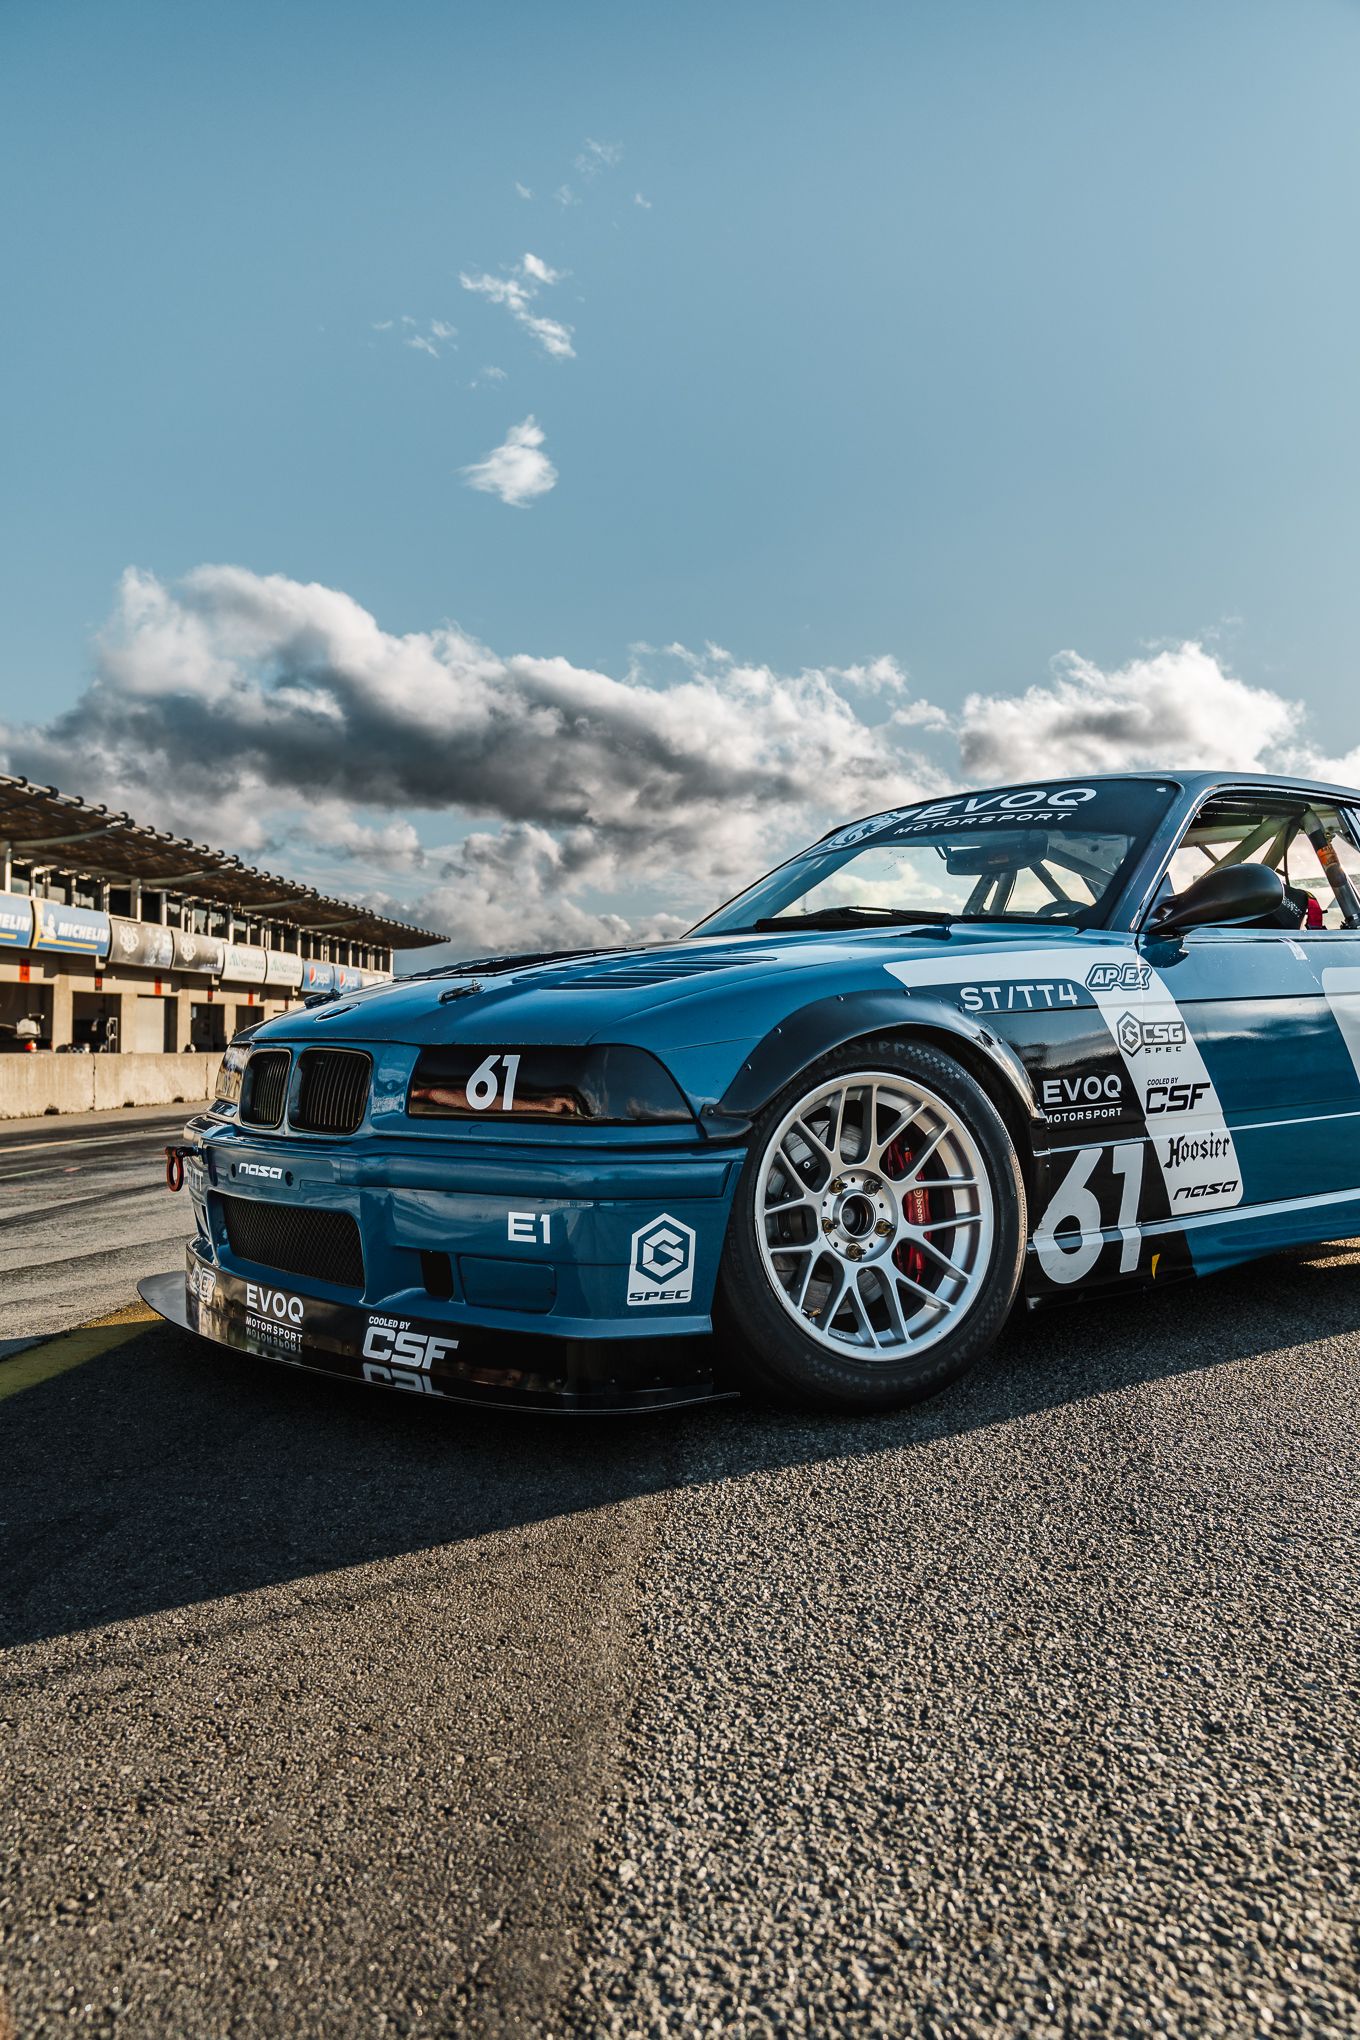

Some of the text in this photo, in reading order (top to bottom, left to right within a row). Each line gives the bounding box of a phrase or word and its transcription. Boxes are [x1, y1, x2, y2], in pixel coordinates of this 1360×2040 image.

[912, 788, 1097, 821] EVOQ
[893, 813, 1073, 835] MOTORSPORT
[0, 912, 31, 932] ELIN
[57, 921, 109, 943] MICHELIN
[1090, 968, 1148, 985] APEX
[960, 983, 1078, 1011] ST/TT4
[1142, 1023, 1184, 1043] CSG
[1144, 1045, 1182, 1054] SPEC
[465, 1054, 521, 1111] 61
[1042, 1074, 1122, 1104] EVOQ
[1147, 1076, 1179, 1087] COOLED BY
[1145, 1082, 1211, 1115] CSF
[1045, 1107, 1123, 1124] MOTORSPORT
[1163, 1131, 1231, 1169] Hoosier
[238, 1162, 283, 1180] nasa
[1172, 1179, 1239, 1201] nasa
[1032, 1142, 1145, 1285] 61
[507, 1211, 551, 1244] E1
[246, 1282, 304, 1324] EVOQ
[628, 1289, 690, 1302] SPEC
[245, 1315, 303, 1343] MOTORSPORT
[368, 1315, 411, 1330] COOLED BY
[362, 1326, 459, 1371] CSF
